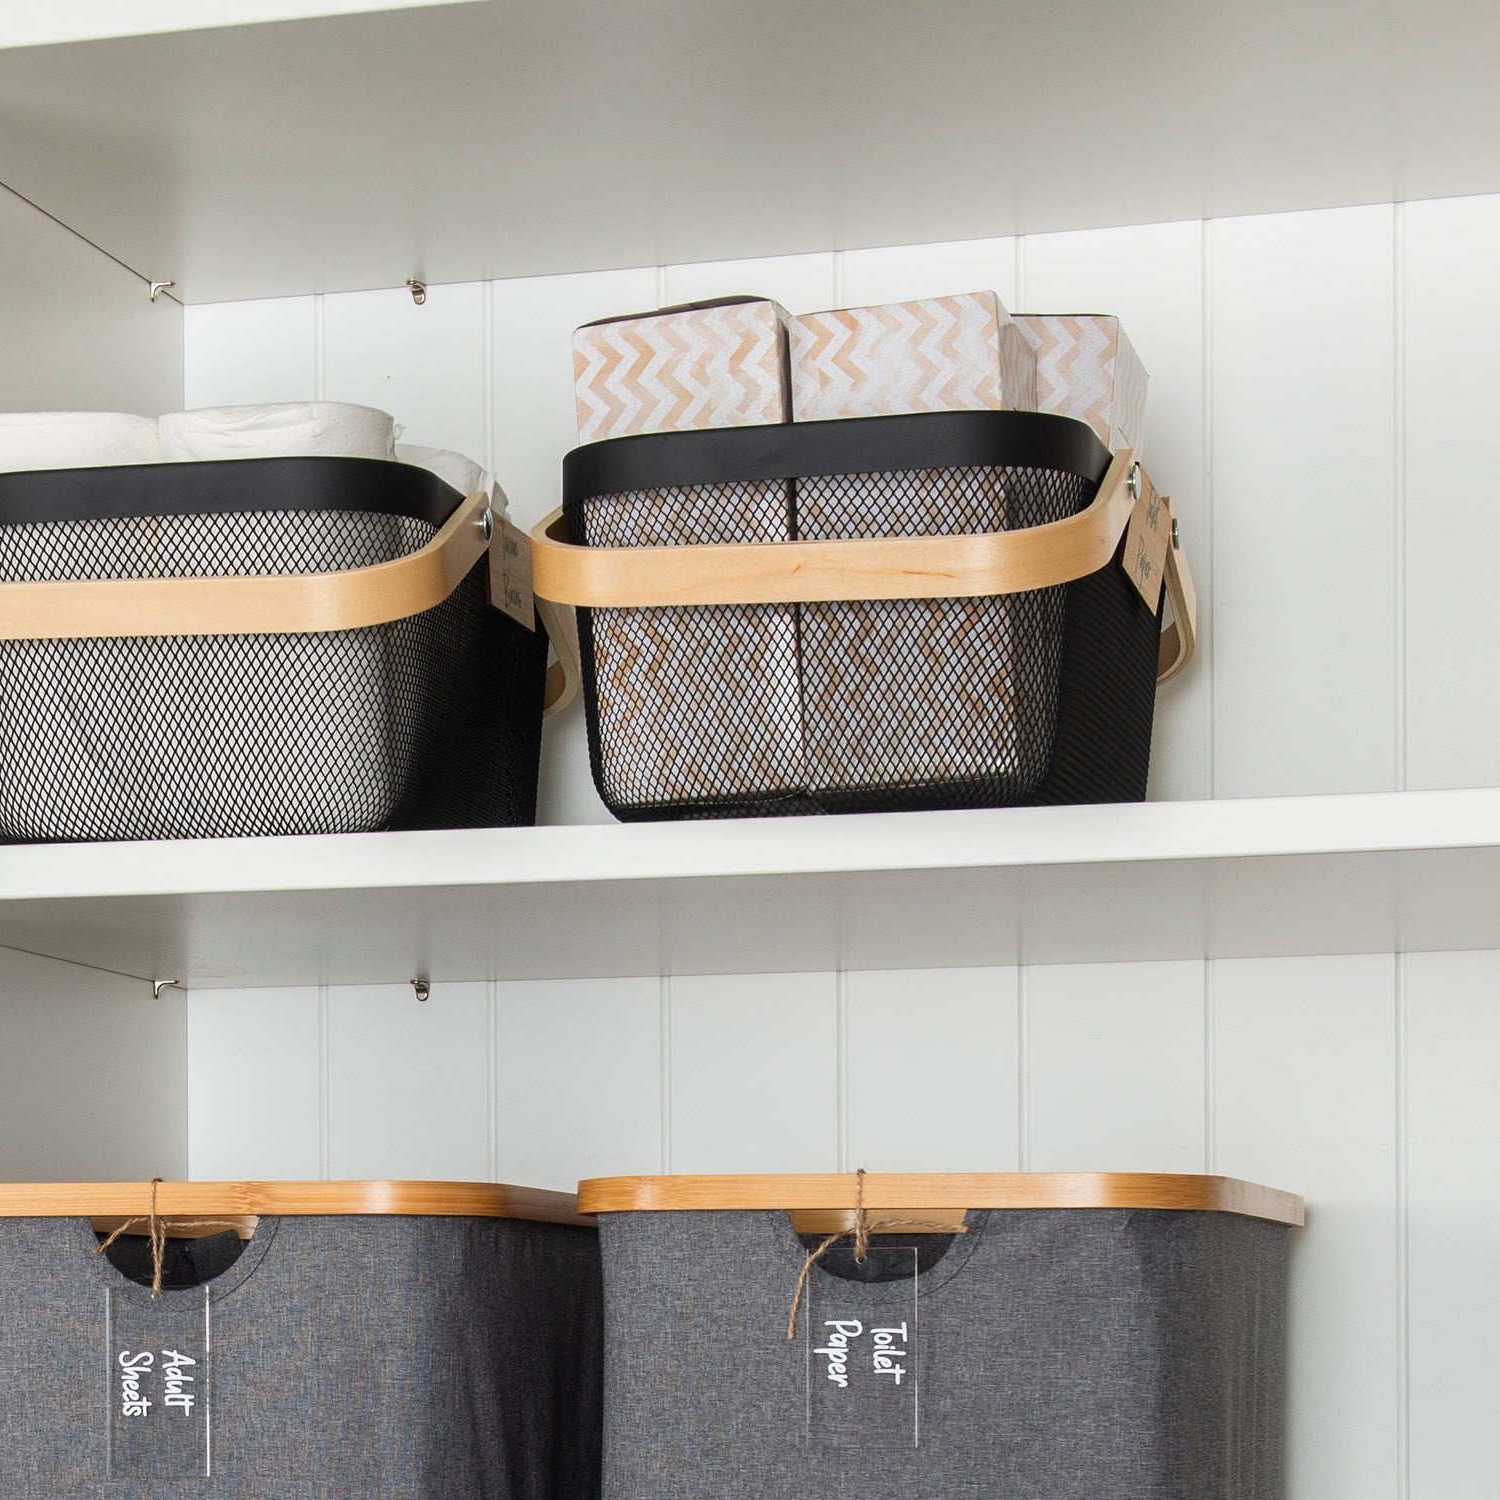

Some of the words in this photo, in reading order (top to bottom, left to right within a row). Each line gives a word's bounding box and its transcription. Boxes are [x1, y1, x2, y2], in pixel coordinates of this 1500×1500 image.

[119, 1350, 154, 1417] Sheets
[161, 1349, 196, 1417] Adult
[813, 1319, 863, 1388] Paper
[870, 1321, 908, 1385] Toilet
